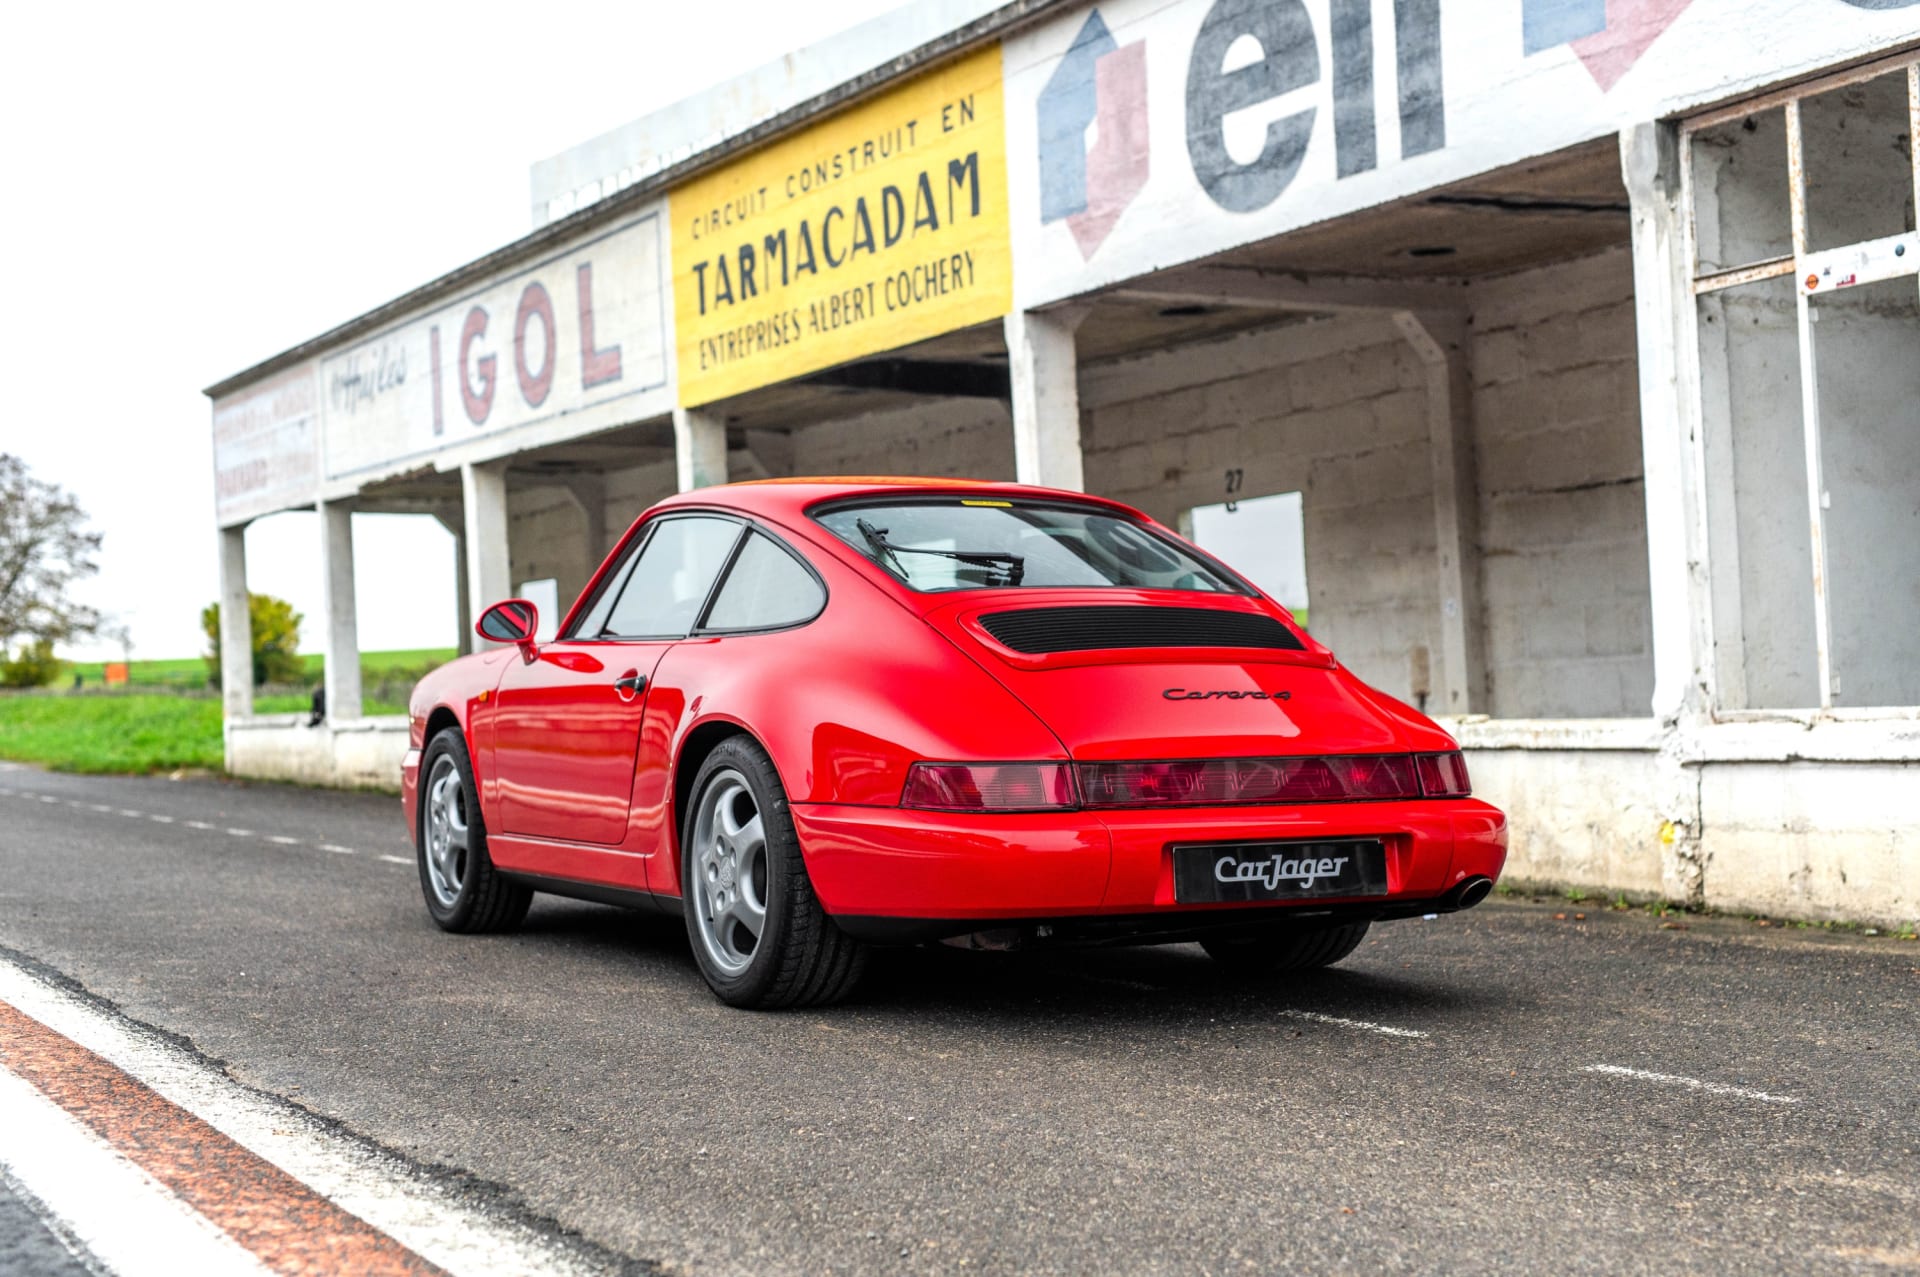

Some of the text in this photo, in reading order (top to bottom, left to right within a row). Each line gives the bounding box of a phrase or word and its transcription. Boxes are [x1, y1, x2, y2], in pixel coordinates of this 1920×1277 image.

[692, 94, 976, 240] CIRCUIT CONSTRUIT EN
[692, 151, 981, 317] TARMACADAM
[429, 262, 622, 436] IGOL
[699, 250, 977, 371] ENTREPRISES ALBERT COCHERY
[1225, 468, 1244, 494] 27
[1162, 688, 1292, 701] Carrera 4
[1214, 854, 1349, 891] CarJager
